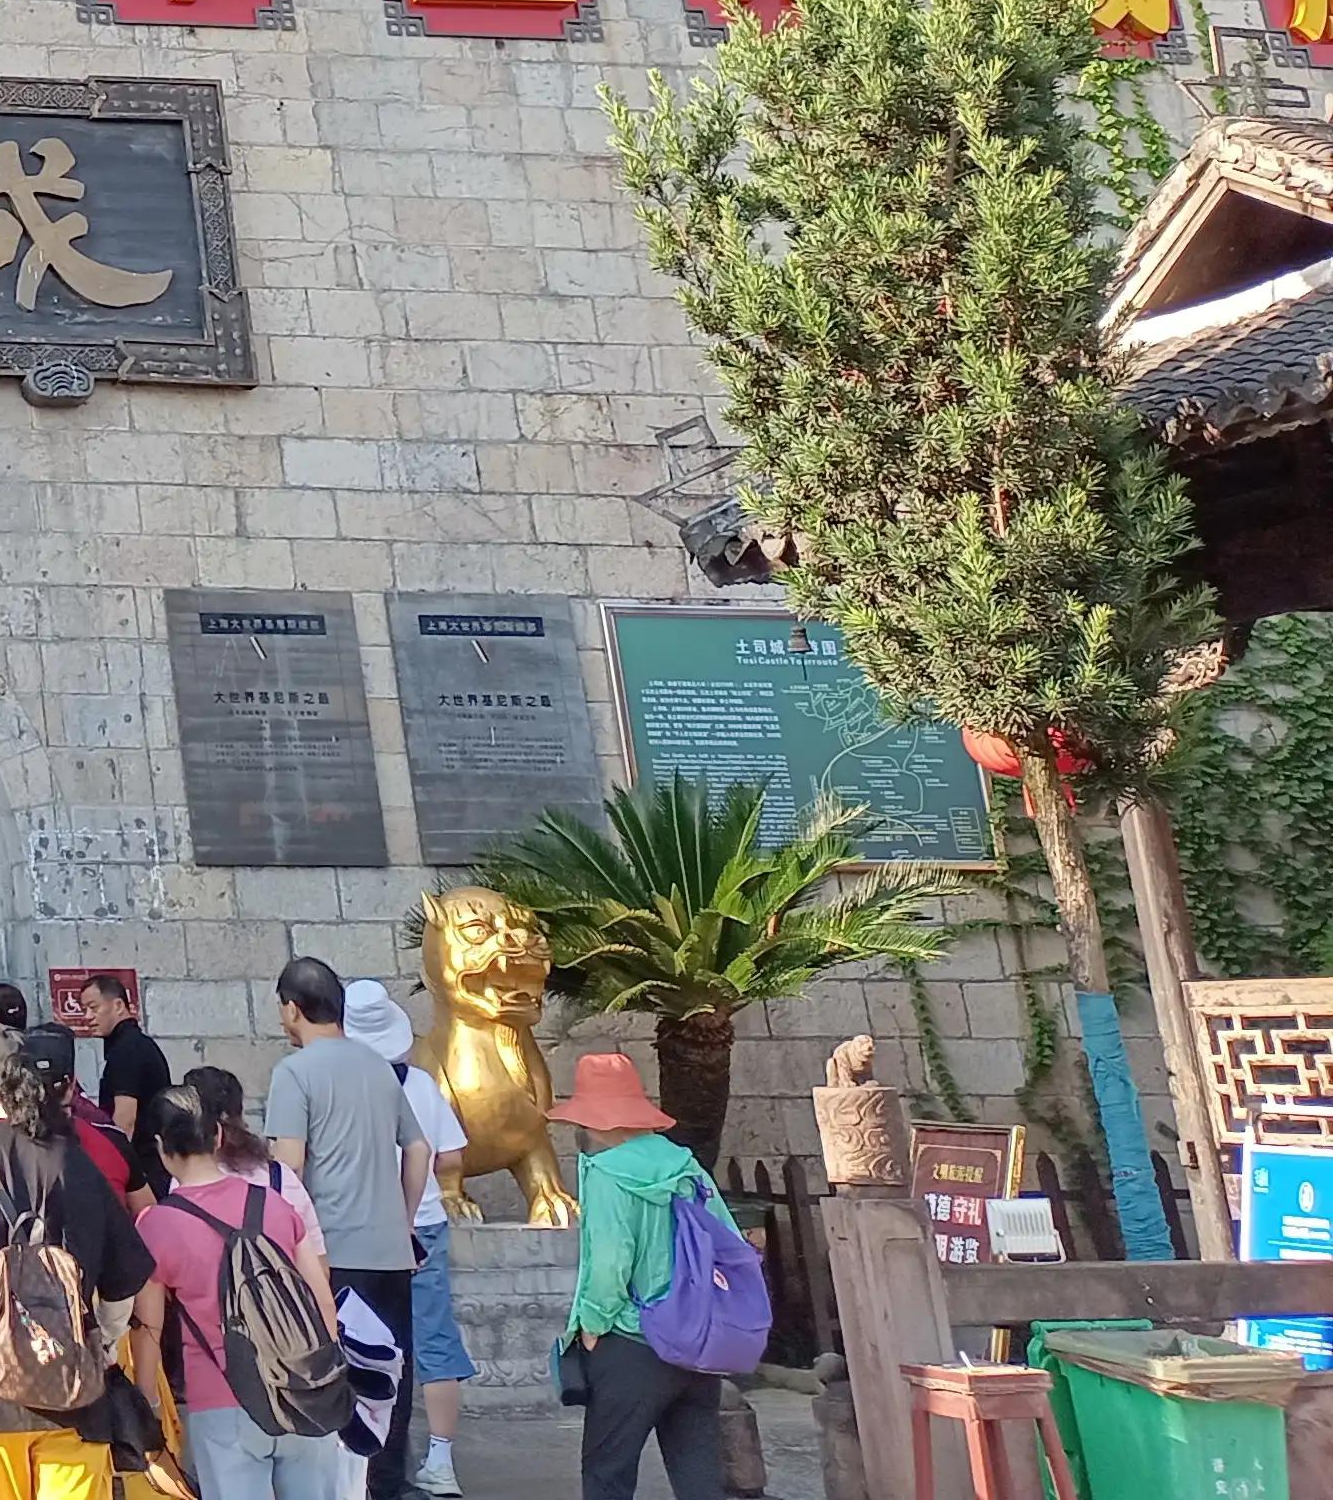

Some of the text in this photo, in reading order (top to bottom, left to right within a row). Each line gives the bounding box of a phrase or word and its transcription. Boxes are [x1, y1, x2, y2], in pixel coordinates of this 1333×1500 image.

[214, 691, 330, 705] 大世界基尼斯之最
[438, 694, 553, 707] 大世界基尼斯之最
